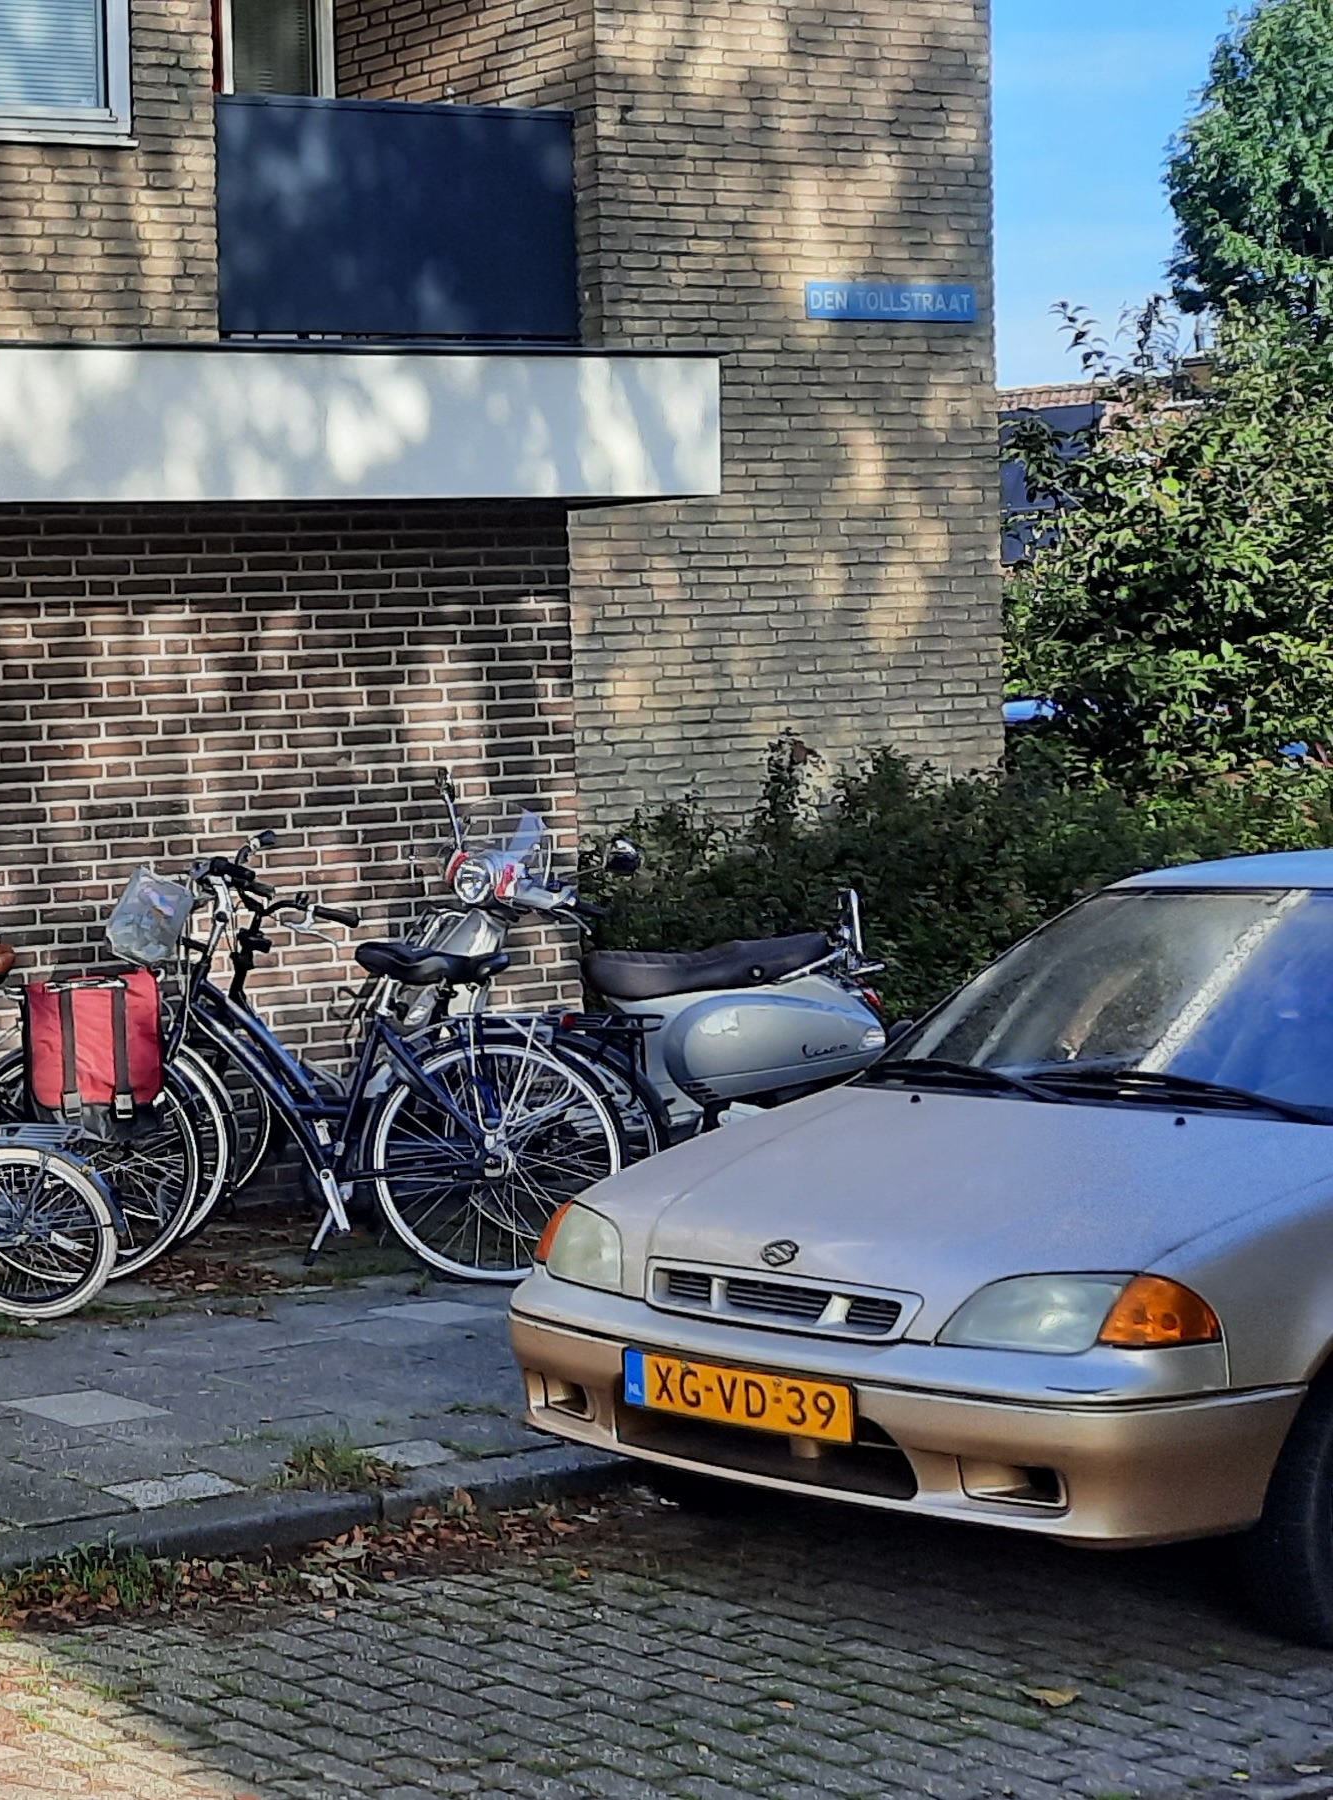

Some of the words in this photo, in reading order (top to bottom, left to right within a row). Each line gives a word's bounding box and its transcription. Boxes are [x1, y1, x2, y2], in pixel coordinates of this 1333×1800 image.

[809, 289, 848, 311] DEN
[858, 291, 971, 313] TOLLSTRAAT
[654, 1362, 837, 1430] XG-VD-39
